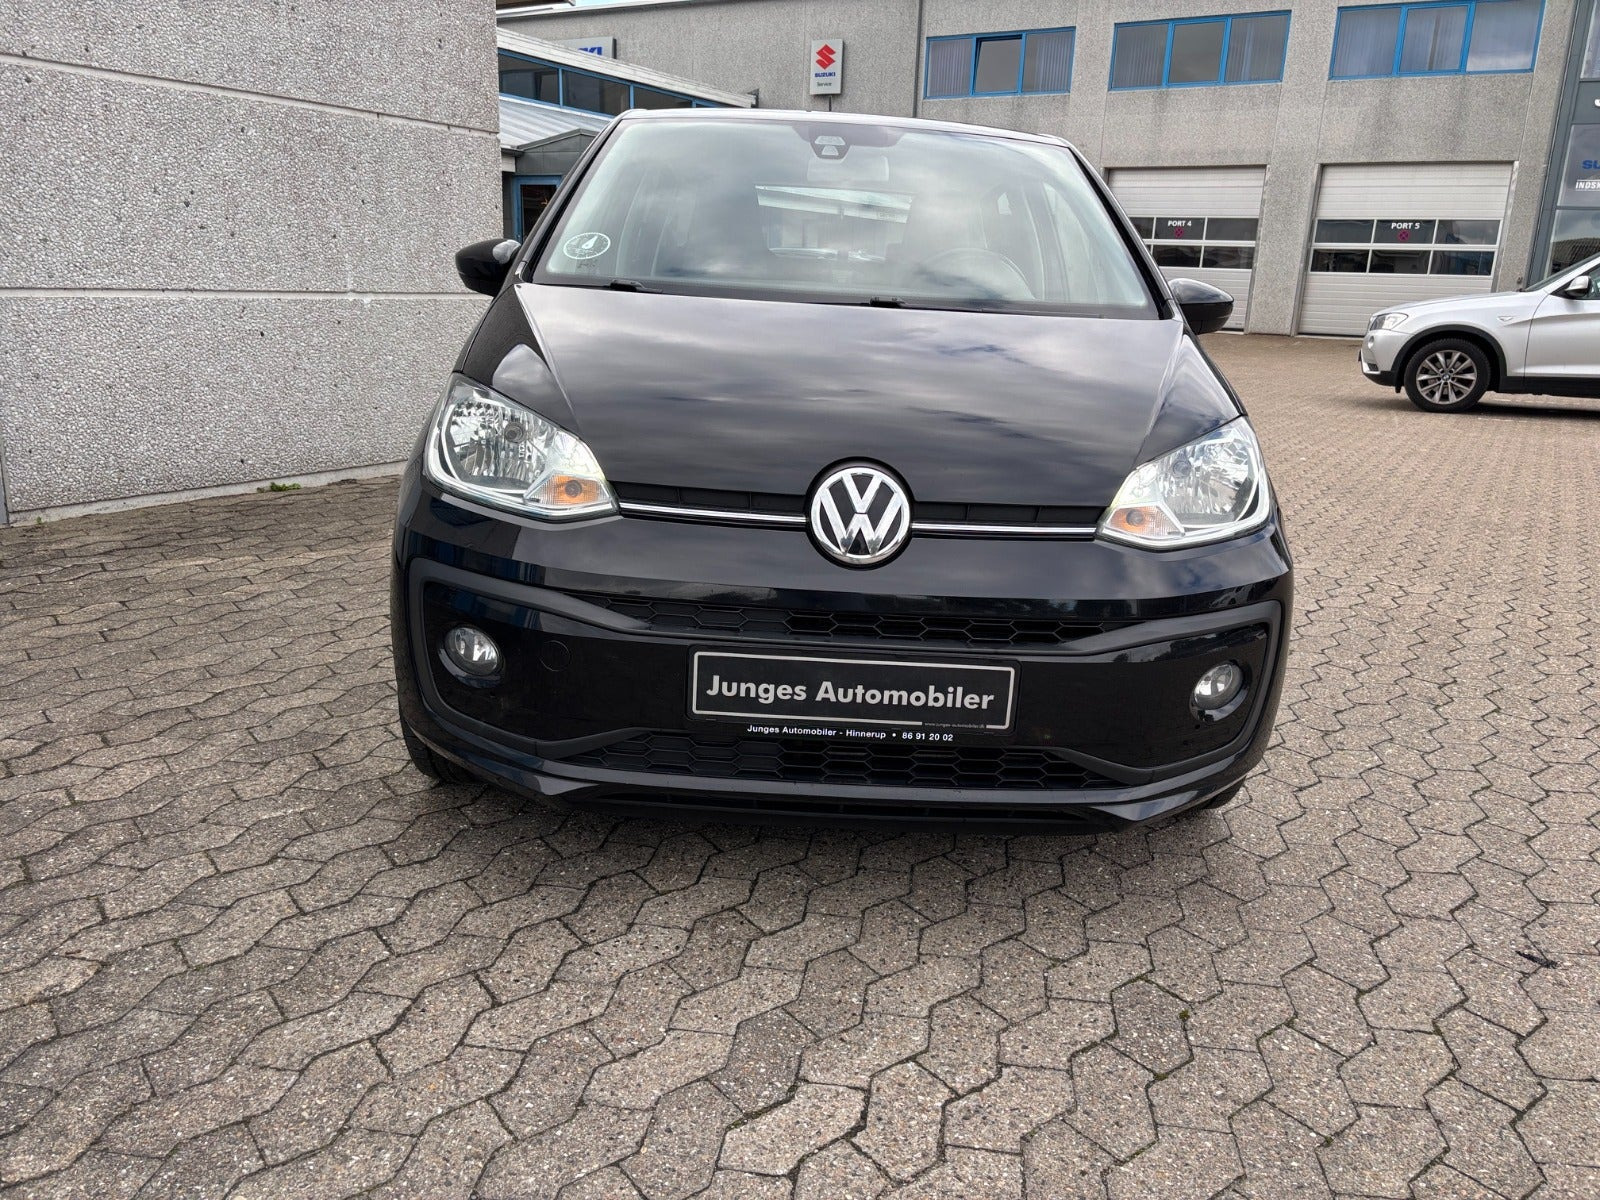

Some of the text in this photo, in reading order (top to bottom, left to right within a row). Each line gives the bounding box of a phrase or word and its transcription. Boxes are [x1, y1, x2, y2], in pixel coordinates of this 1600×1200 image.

[706, 674, 994, 709] Junges Automobiler
[747, 725, 779, 734] Junges
[782, 726, 837, 736] Automobiler
[845, 729, 886, 740] Hinnerup
[902, 732, 913, 740] 86
[929, 733, 940, 741] 20
[942, 734, 954, 742] 02
